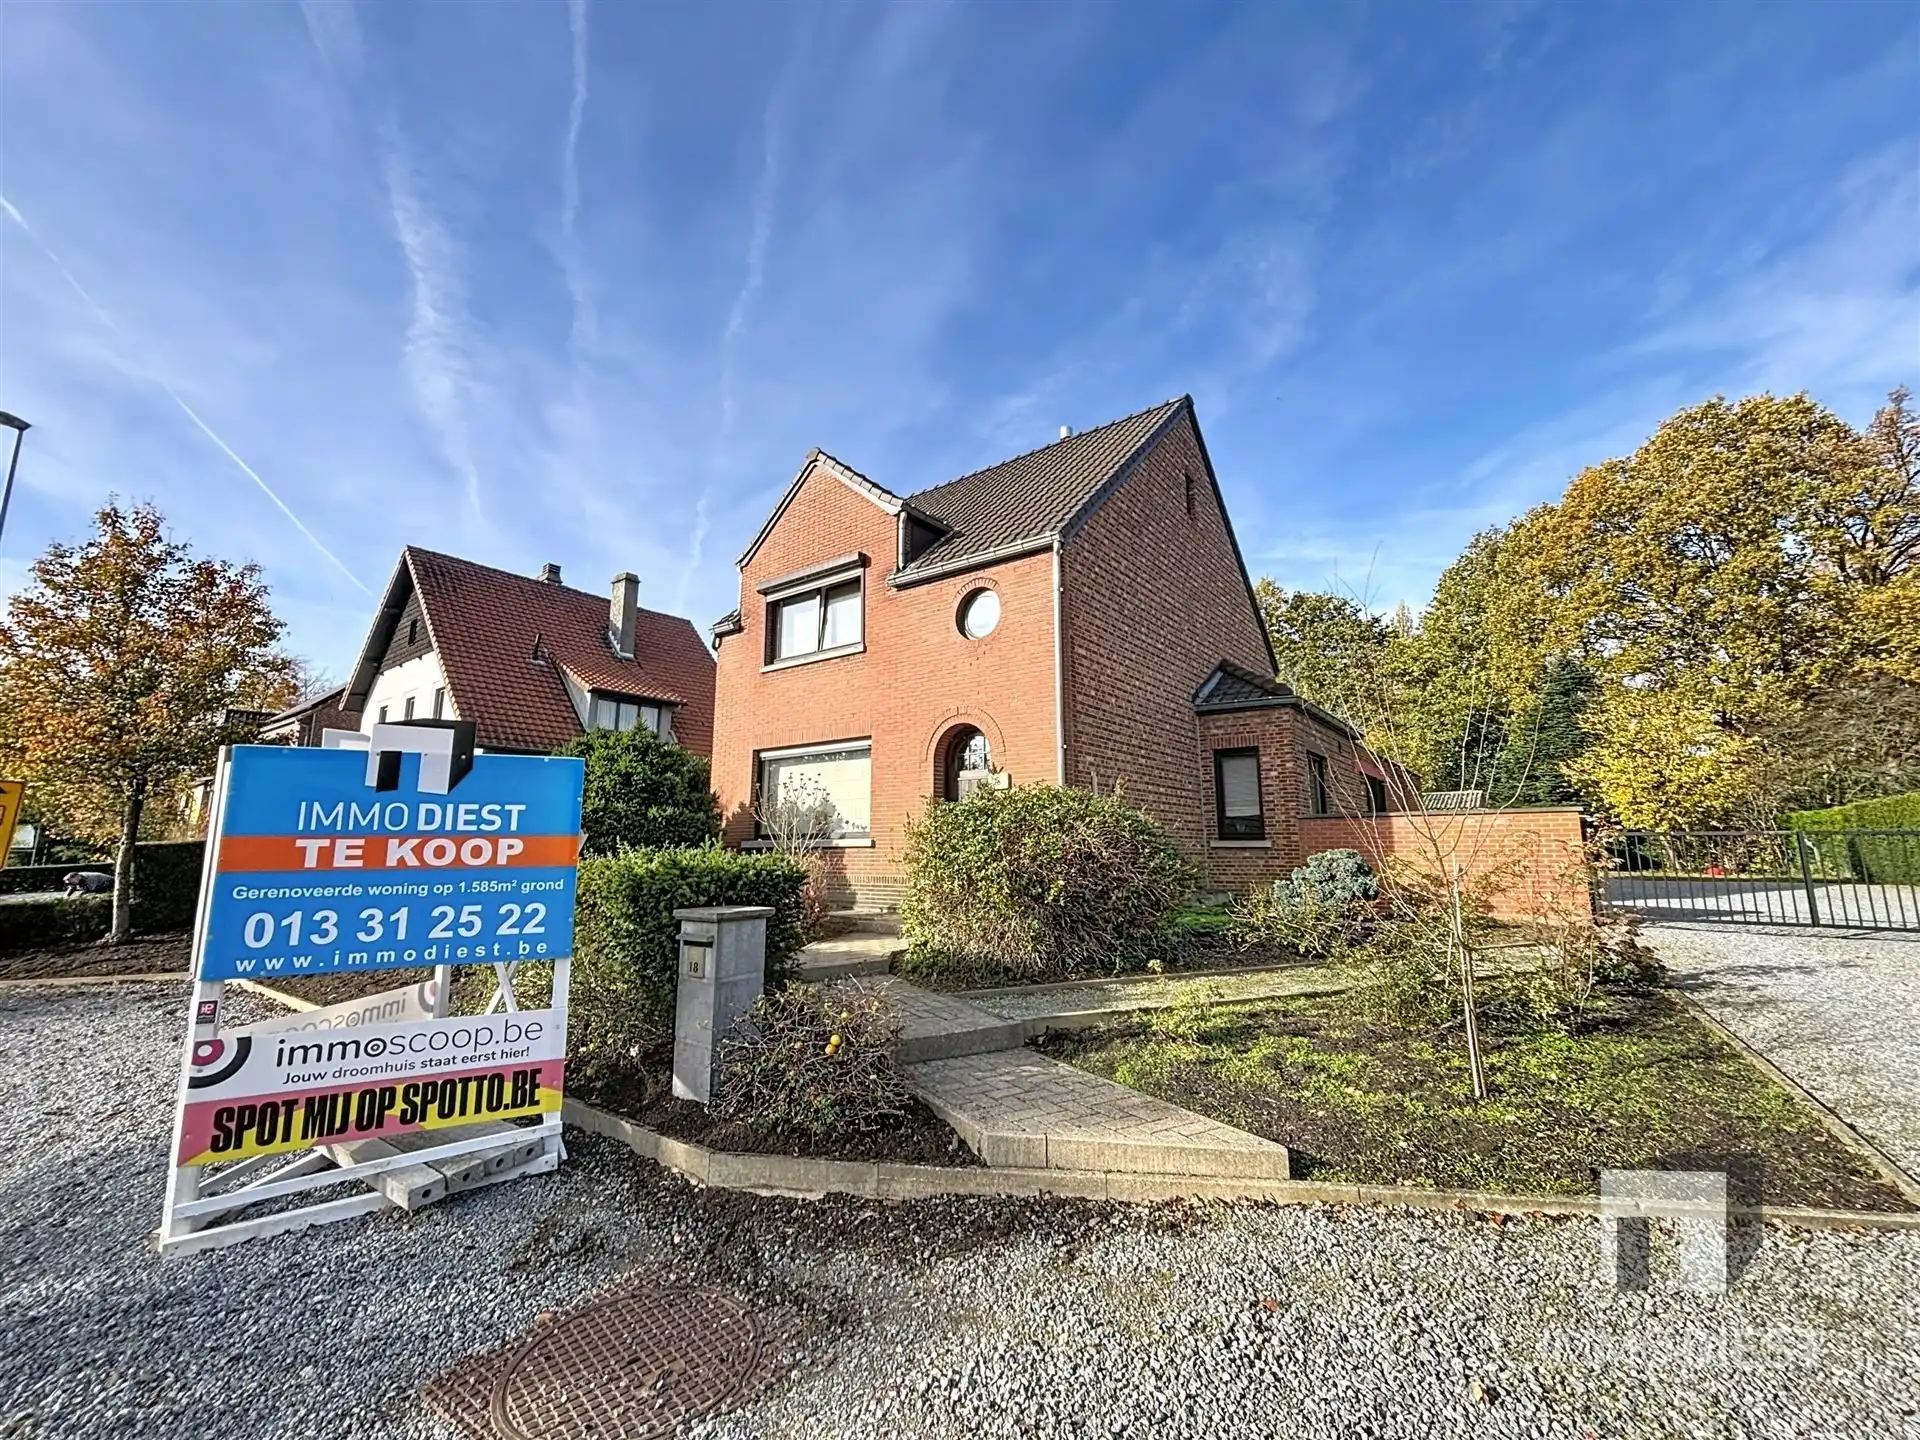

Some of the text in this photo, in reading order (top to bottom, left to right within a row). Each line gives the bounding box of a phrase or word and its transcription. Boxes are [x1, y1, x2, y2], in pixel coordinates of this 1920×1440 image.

[298, 801, 526, 831] IMMO DIEST
[295, 838, 524, 868] TE KOOP
[232, 884, 362, 900] Gerenoveerde
[368, 882, 428, 897] woning
[433, 884, 453, 896] op
[521, 879, 564, 894] grond
[244, 902, 547, 948] 013 31 25 22
[236, 940, 547, 973] www.immodiest.be
[689, 961, 699, 973] 18
[276, 1018, 543, 1067] immoscoop.be
[282, 1046, 530, 1085] Jouw droomhuis staat eerst hier!
[210, 1068, 543, 1153] SPOT MIJ OP SPOTTO.BE
